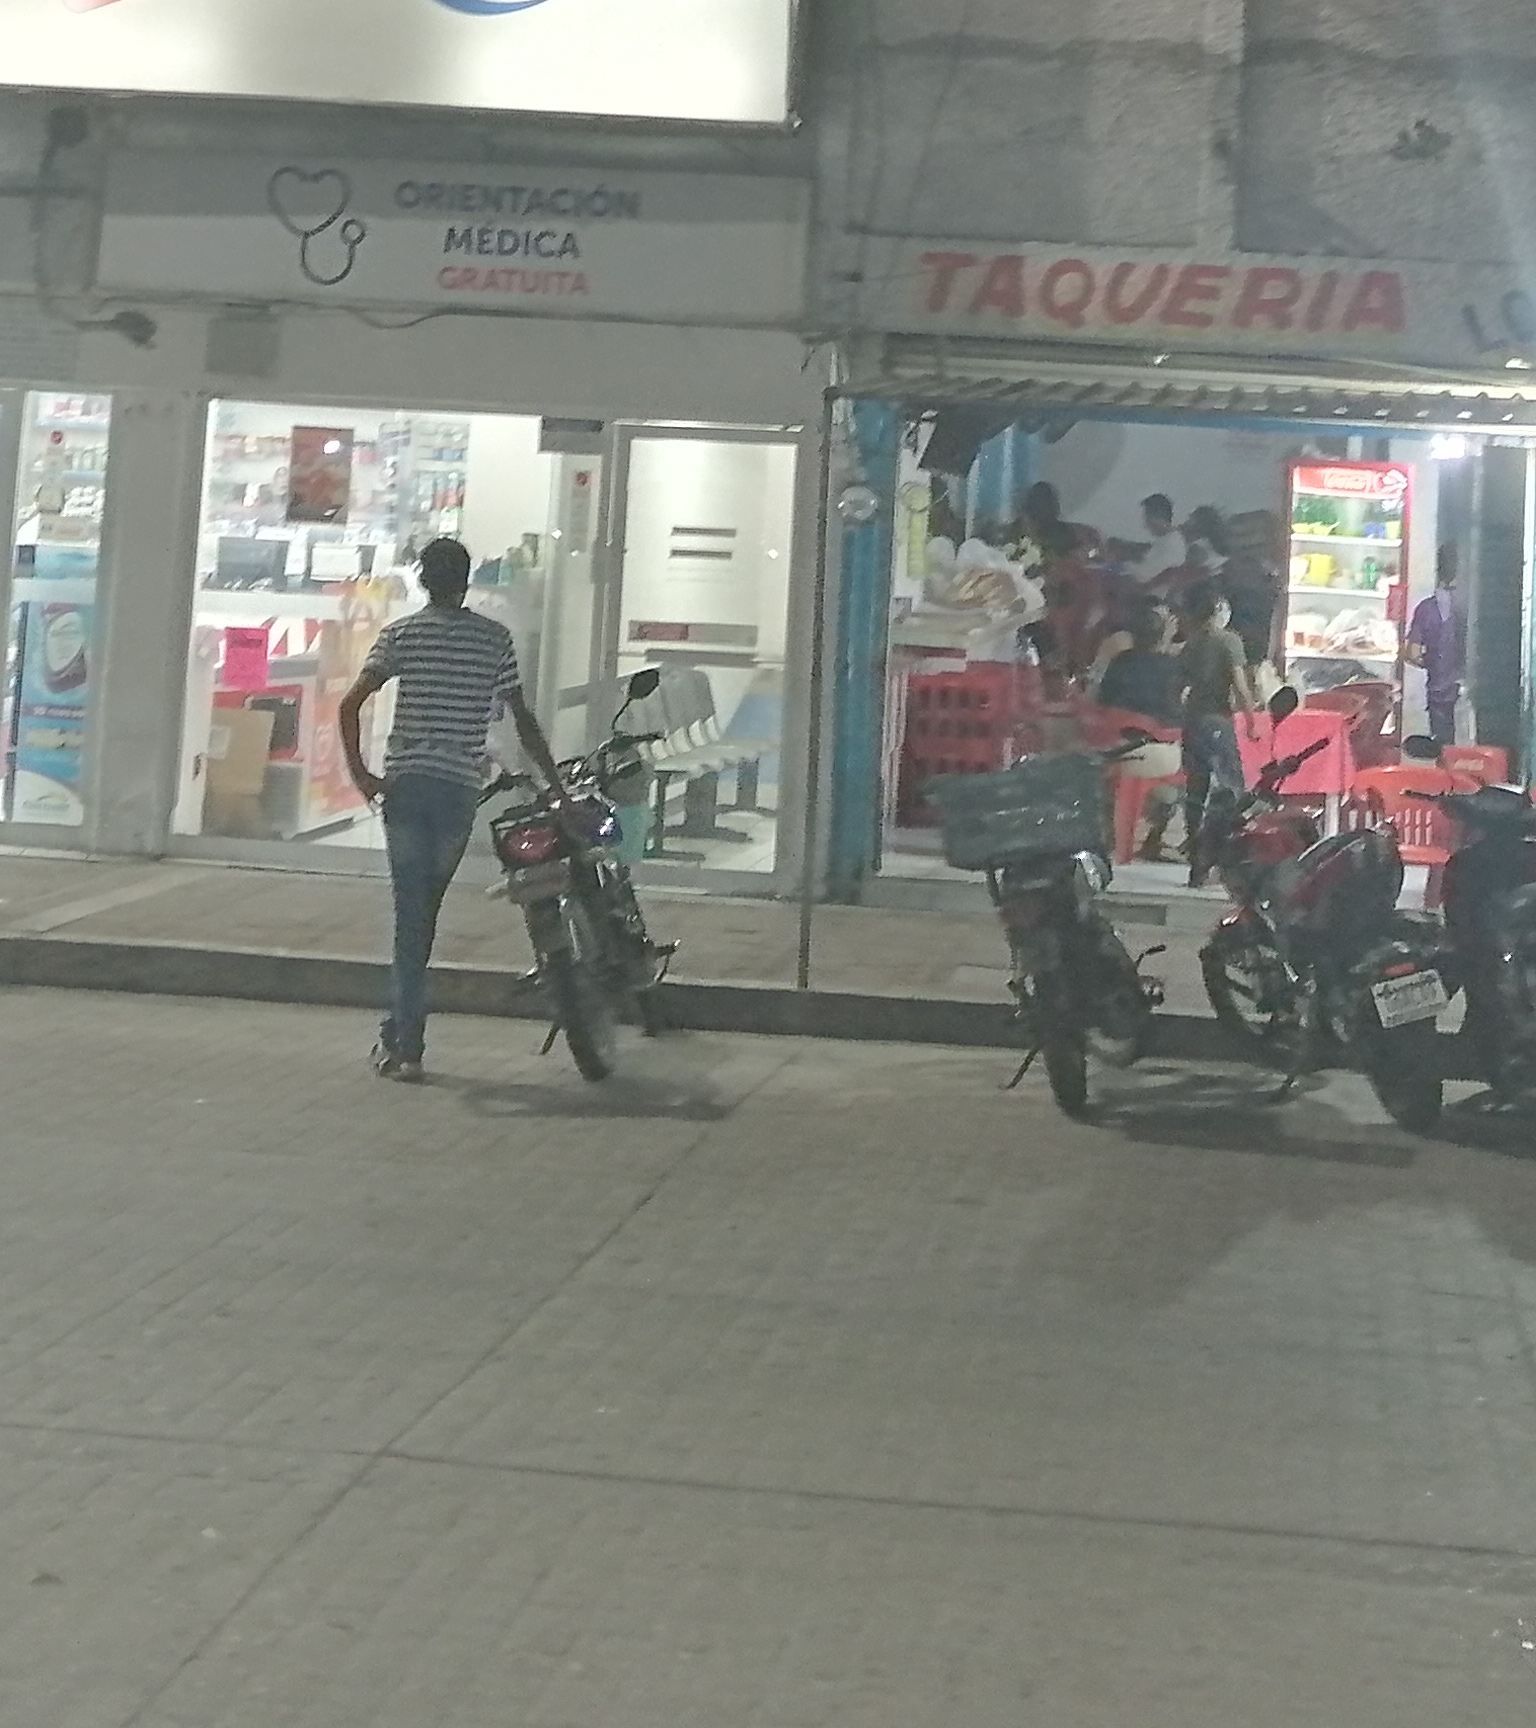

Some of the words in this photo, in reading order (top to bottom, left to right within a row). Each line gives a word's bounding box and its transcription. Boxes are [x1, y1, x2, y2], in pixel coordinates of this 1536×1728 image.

[393, 180, 642, 219] ORIENTACIÓN
[437, 266, 591, 296] GRATUITA
[917, 251, 1407, 334] TAQUERIA
